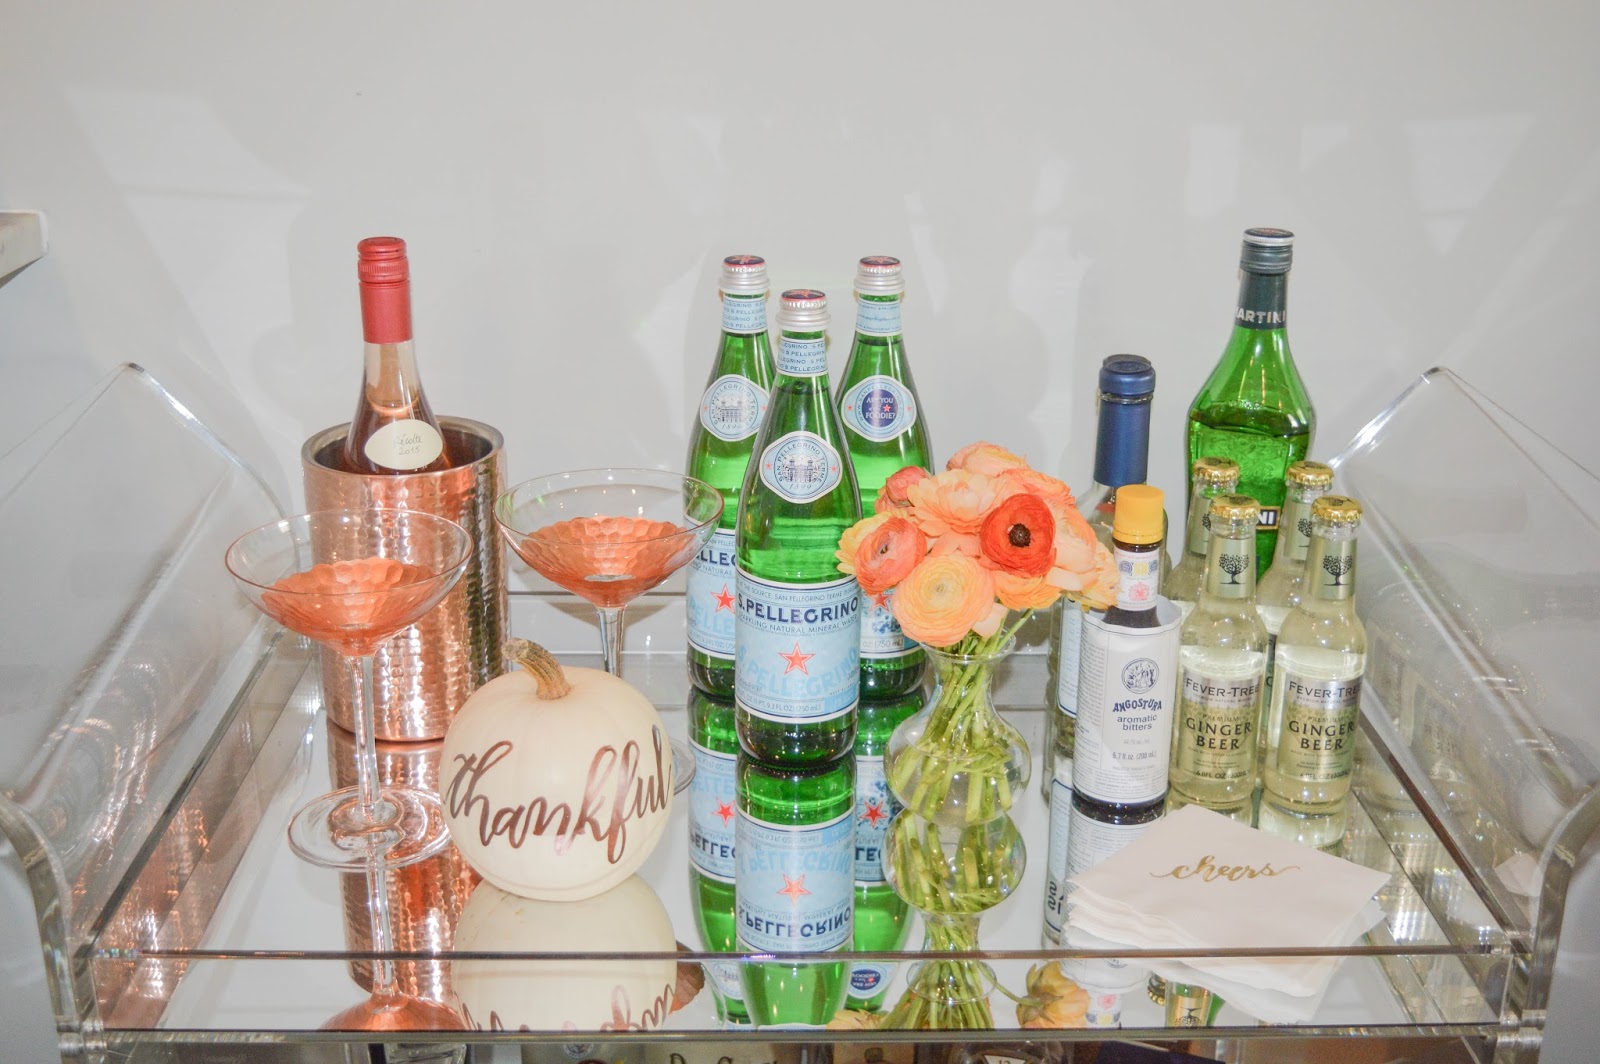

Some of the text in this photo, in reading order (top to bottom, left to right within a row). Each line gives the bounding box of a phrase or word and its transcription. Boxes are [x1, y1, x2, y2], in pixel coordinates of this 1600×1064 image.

[738, 592, 859, 624] S.PELLEGRINO
[769, 624, 805, 634] NATURAL
[808, 623, 840, 634] MINERAL
[1185, 677, 1260, 698] FEVER-TREE
[1112, 698, 1163, 713] ANGOSTURA
[1117, 713, 1158, 724] aromatic
[1122, 722, 1153, 731] bitters
[1185, 717, 1252, 736] GINGER
[1288, 720, 1356, 737] GINGER
[1196, 735, 1240, 750] BEER
[1300, 737, 1344, 751] BEER
[442, 724, 672, 865] thankful
[1148, 854, 1301, 883] cheers
